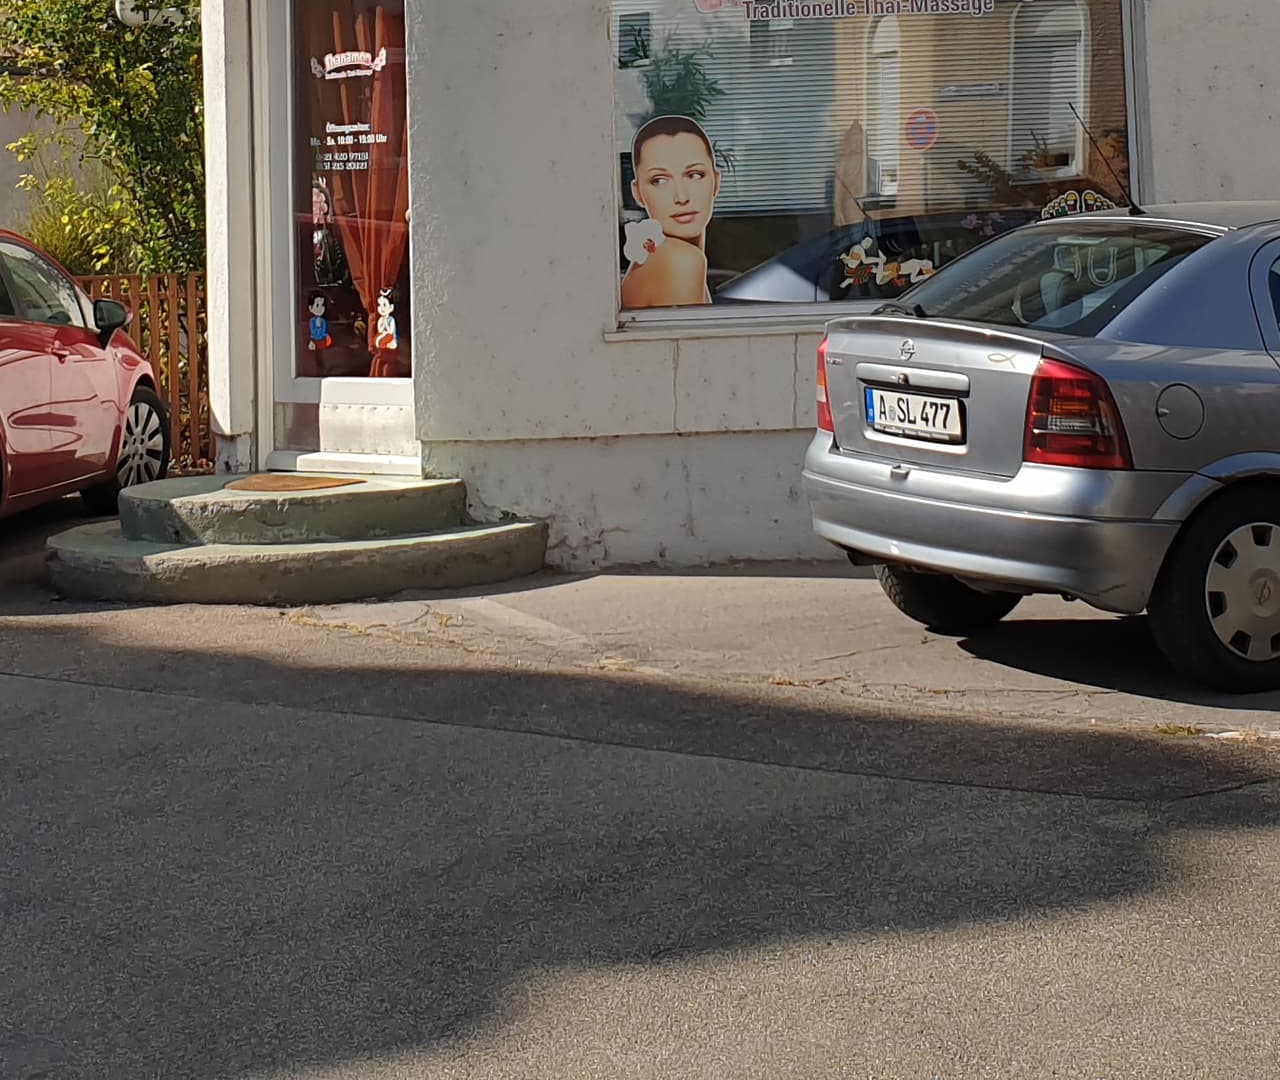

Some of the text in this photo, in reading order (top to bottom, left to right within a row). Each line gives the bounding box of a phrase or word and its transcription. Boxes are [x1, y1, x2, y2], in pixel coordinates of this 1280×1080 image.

[878, 395, 951, 429] A SL 477
